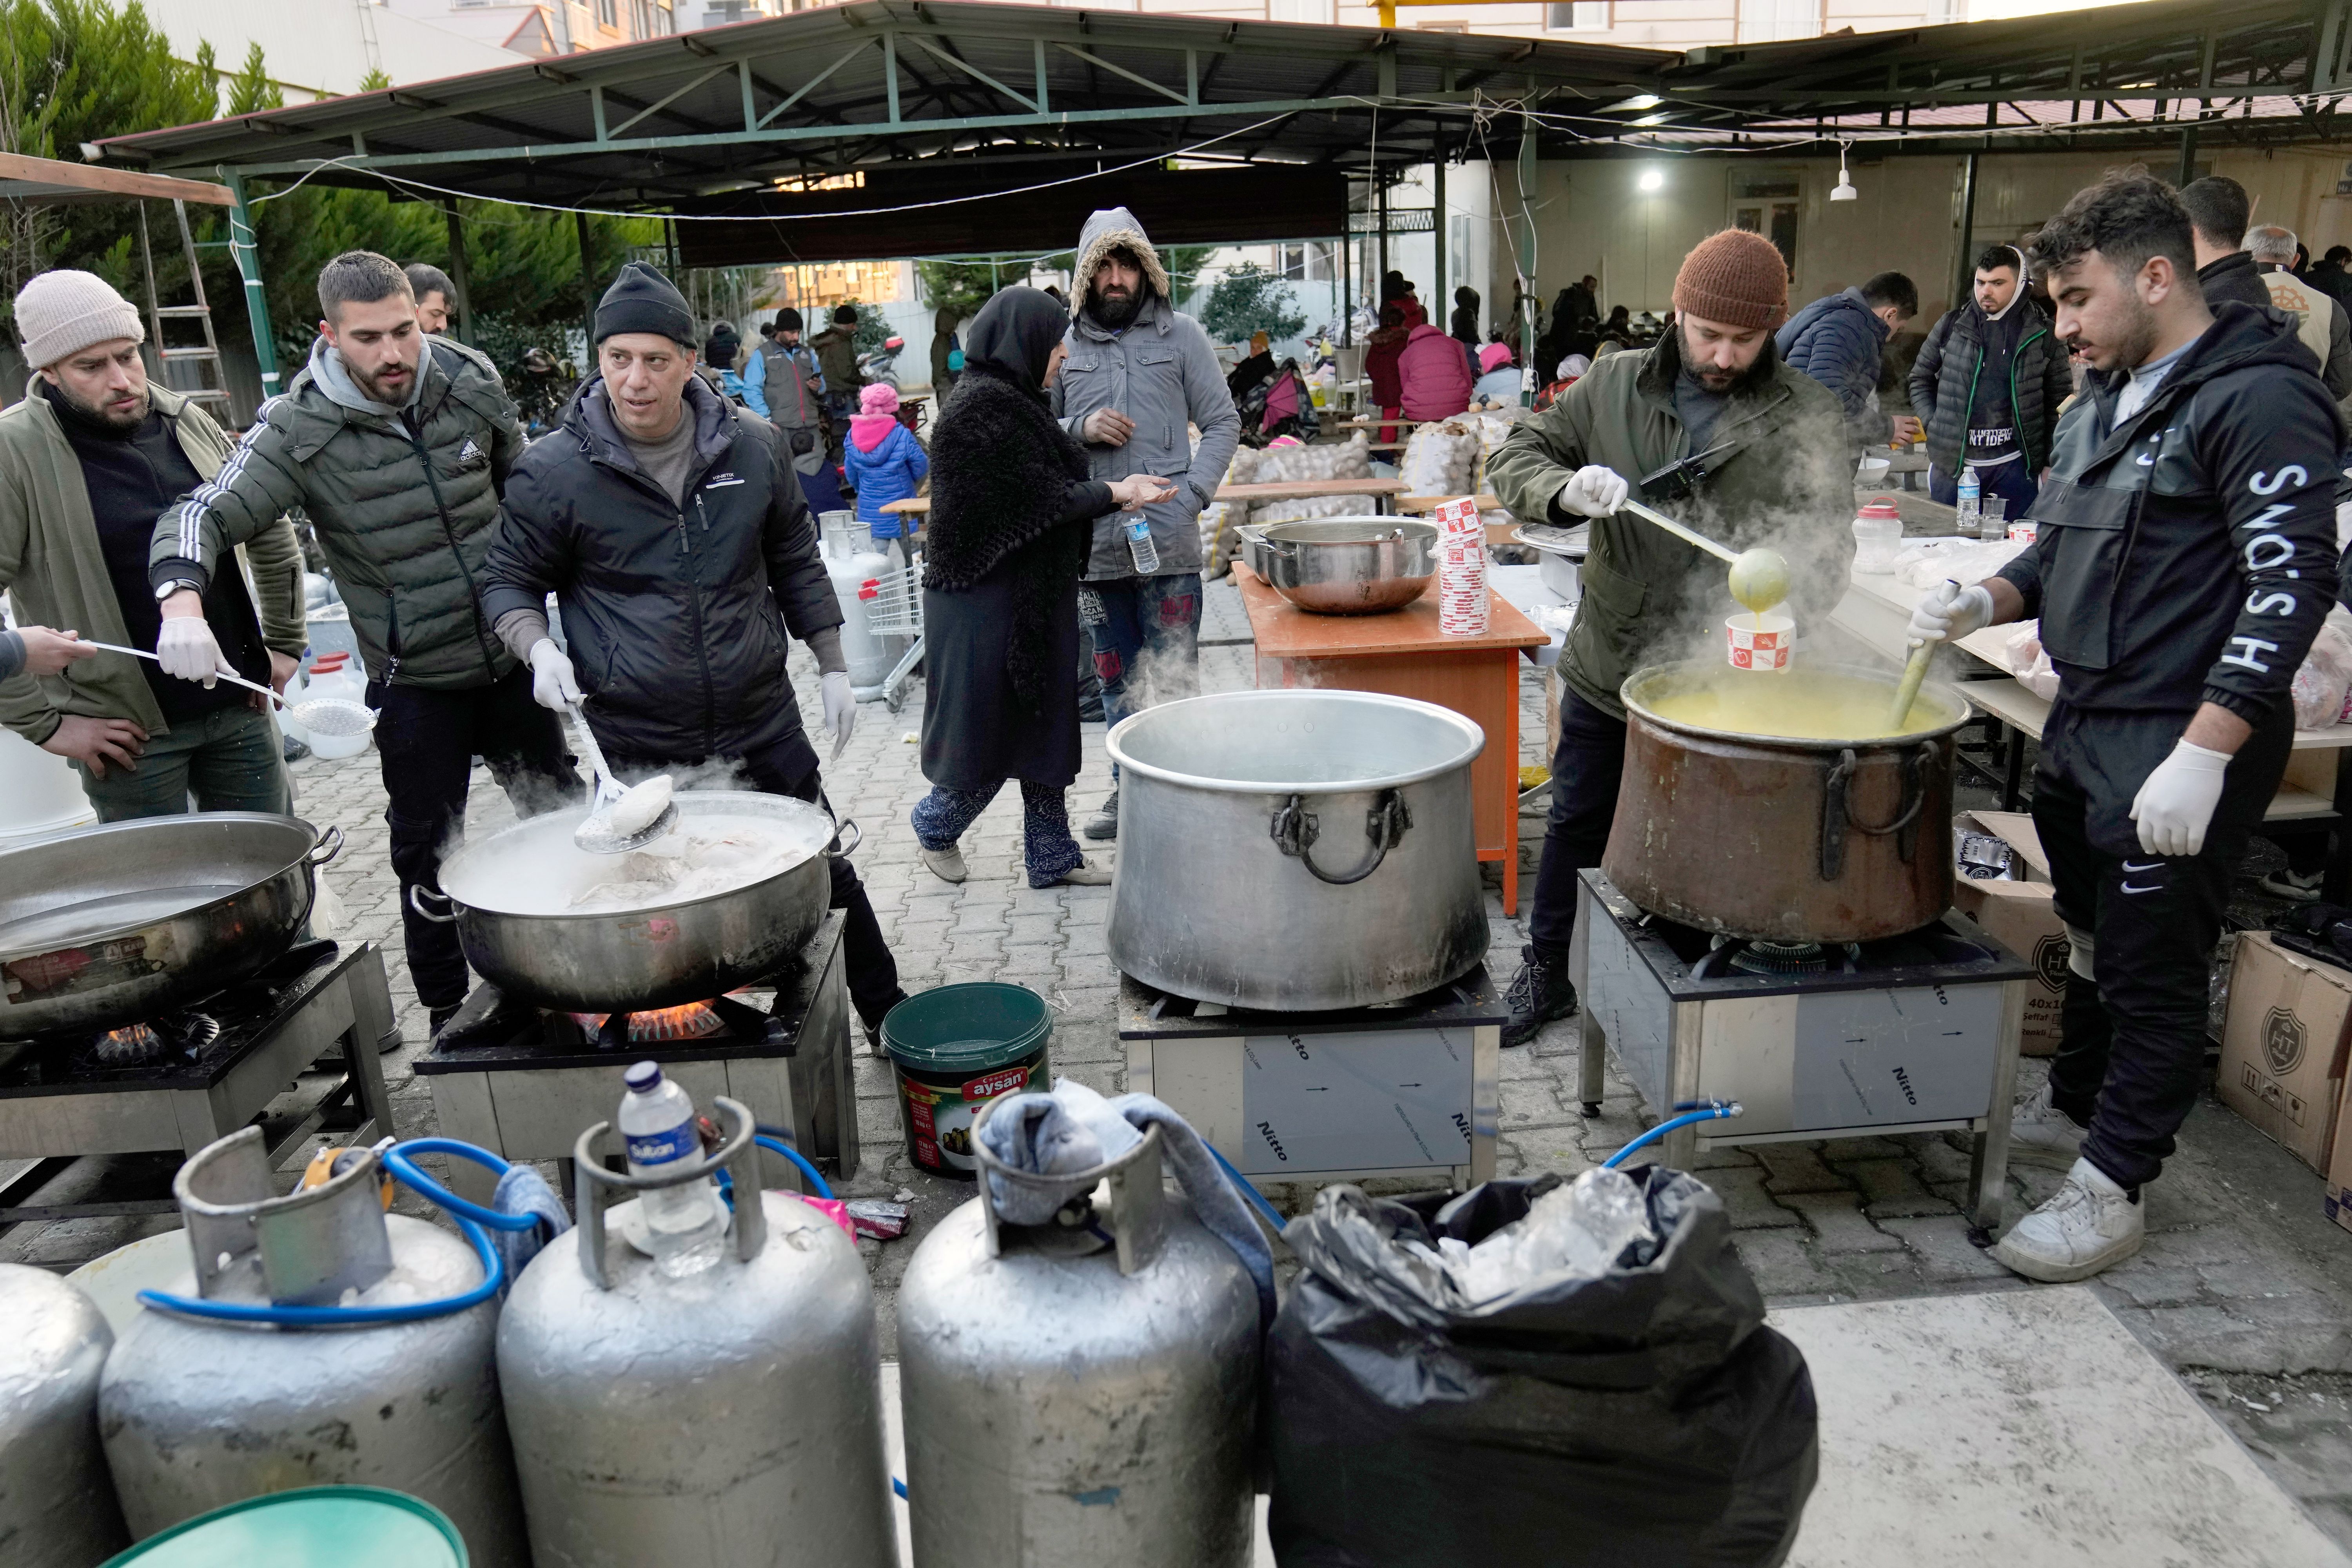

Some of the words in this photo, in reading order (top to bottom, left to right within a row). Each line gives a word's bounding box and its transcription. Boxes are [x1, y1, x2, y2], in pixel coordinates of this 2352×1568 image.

[461, 450, 482, 461] adidas
[1287, 1034, 1309, 1060] itto
[974, 1073, 1021, 1095] aysan
[1892, 1066, 1916, 1105] Nitto
[1257, 1121, 1287, 1161] Nitto
[1451, 1112, 1470, 1144] Nit
[630, 1143, 675, 1159] Sultan
